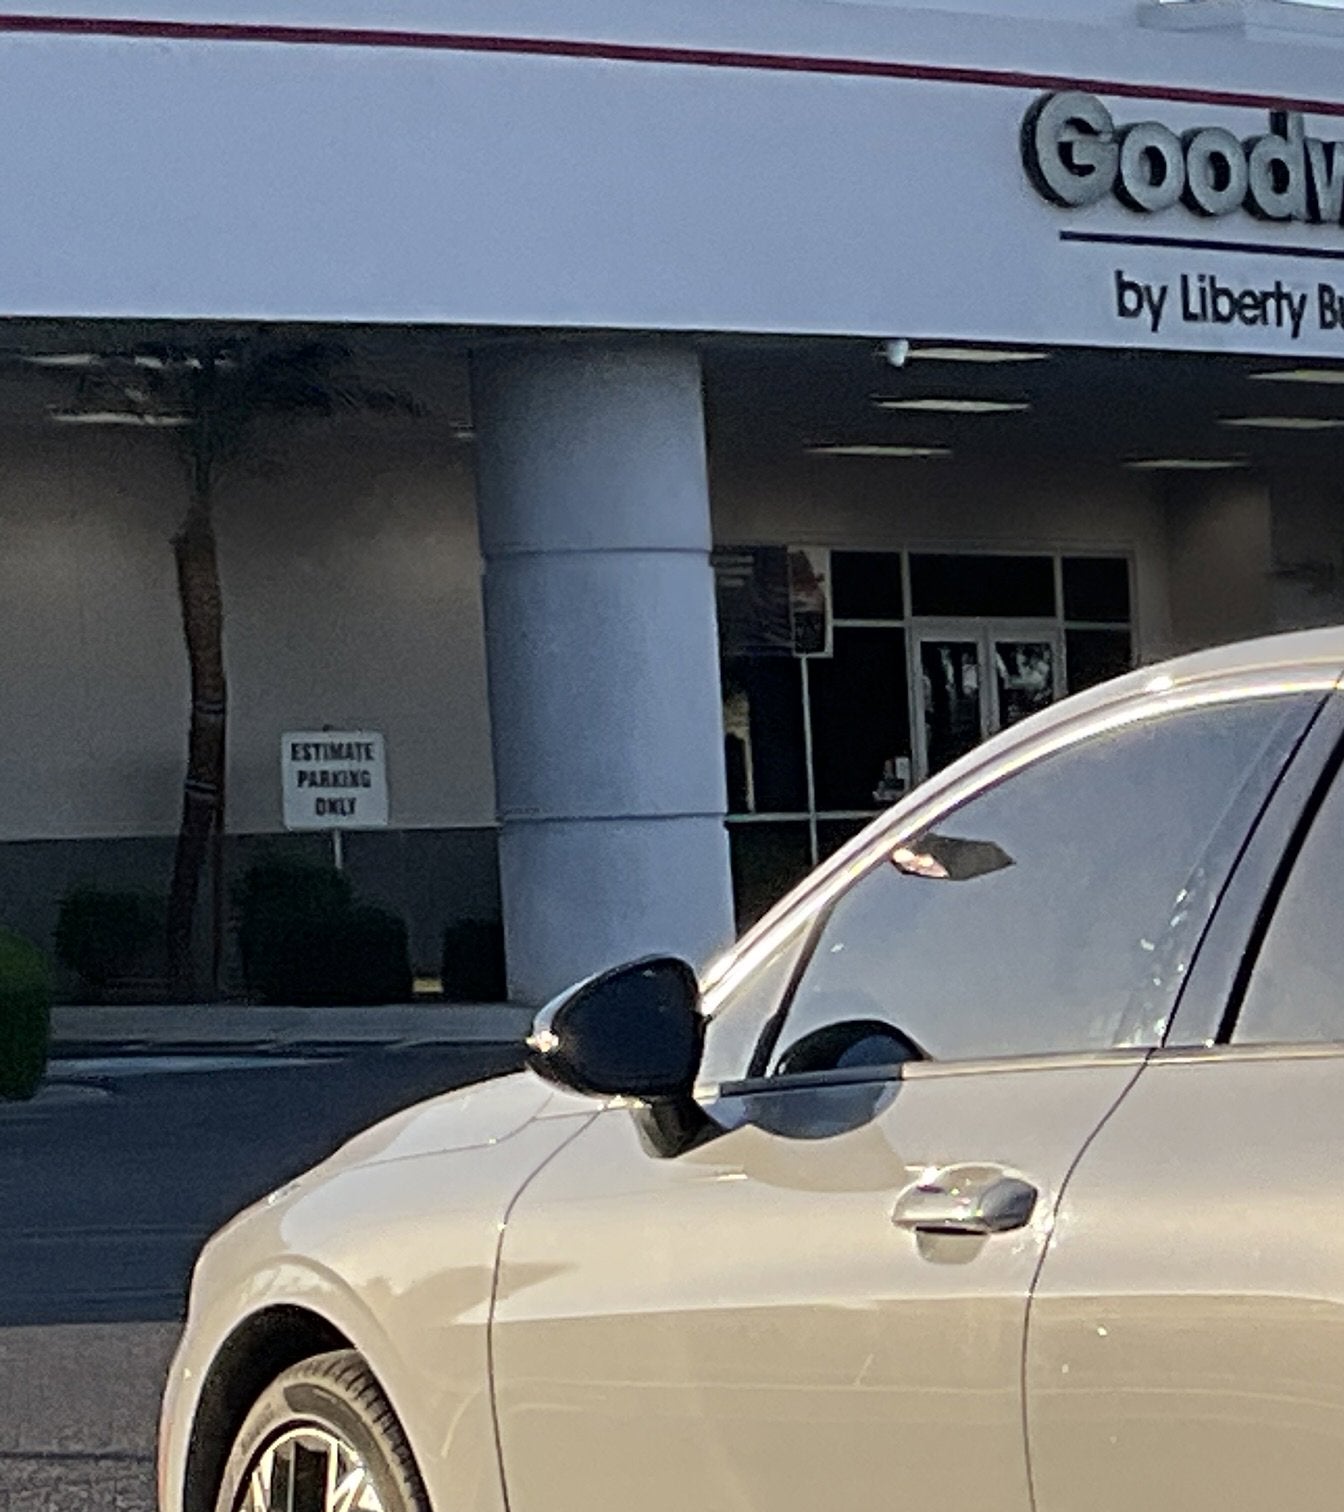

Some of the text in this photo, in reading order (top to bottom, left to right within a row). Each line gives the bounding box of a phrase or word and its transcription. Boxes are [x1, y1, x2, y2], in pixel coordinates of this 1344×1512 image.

[1115, 269, 1168, 333] by
[1180, 273, 1307, 339] Liberty
[290, 742, 375, 762] ESTIMATE
[297, 768, 372, 788] PARKING
[315, 797, 357, 816] ONLY
